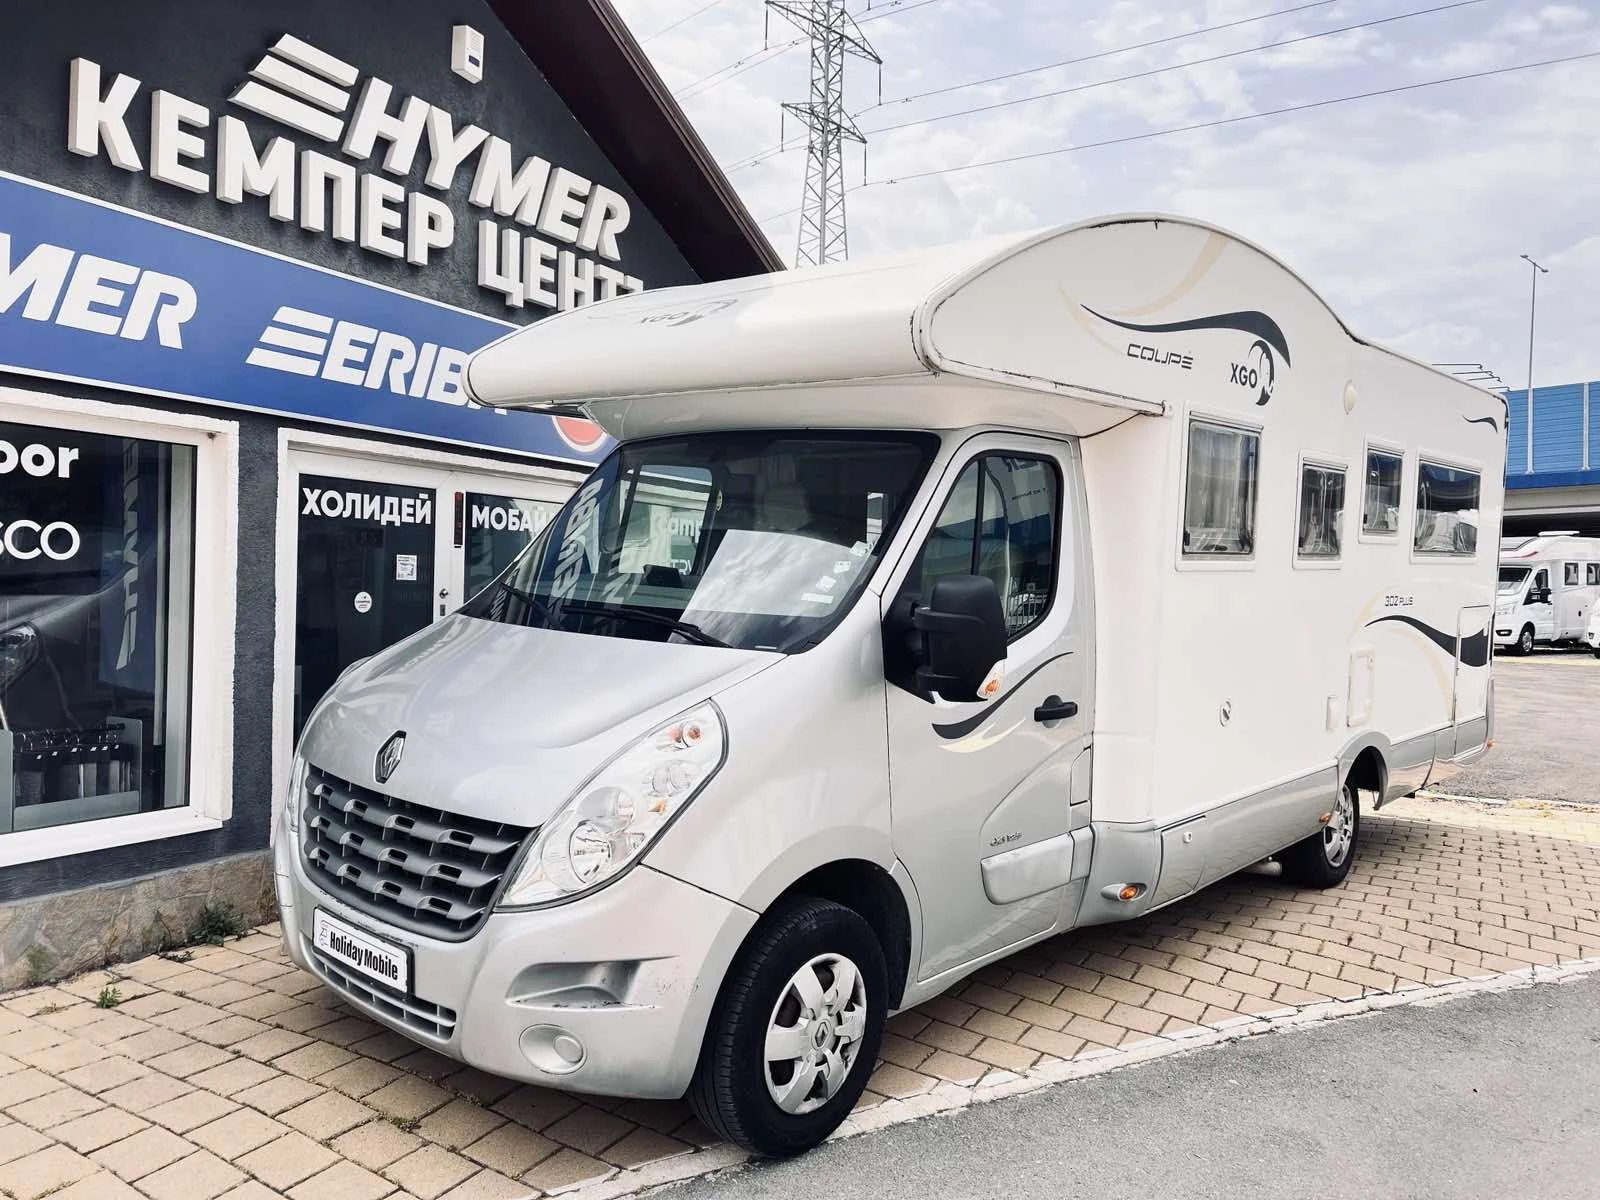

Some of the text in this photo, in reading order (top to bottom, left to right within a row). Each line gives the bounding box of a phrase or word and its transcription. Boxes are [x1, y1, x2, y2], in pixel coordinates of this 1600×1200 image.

[68, 57, 455, 267] КЕМПЕР
[342, 77, 631, 261] HYMER
[0, 232, 197, 349] MER
[321, 320, 507, 415] ERIB
[1230, 363, 1258, 388] XGO
[301, 487, 556, 533] ХОЛИДЕЙ МОБАЙ
[0, 519, 80, 560] CO
[1384, 595, 1399, 607] 302
[330, 931, 363, 967] Holiday
[363, 948, 399, 981] Mobile
